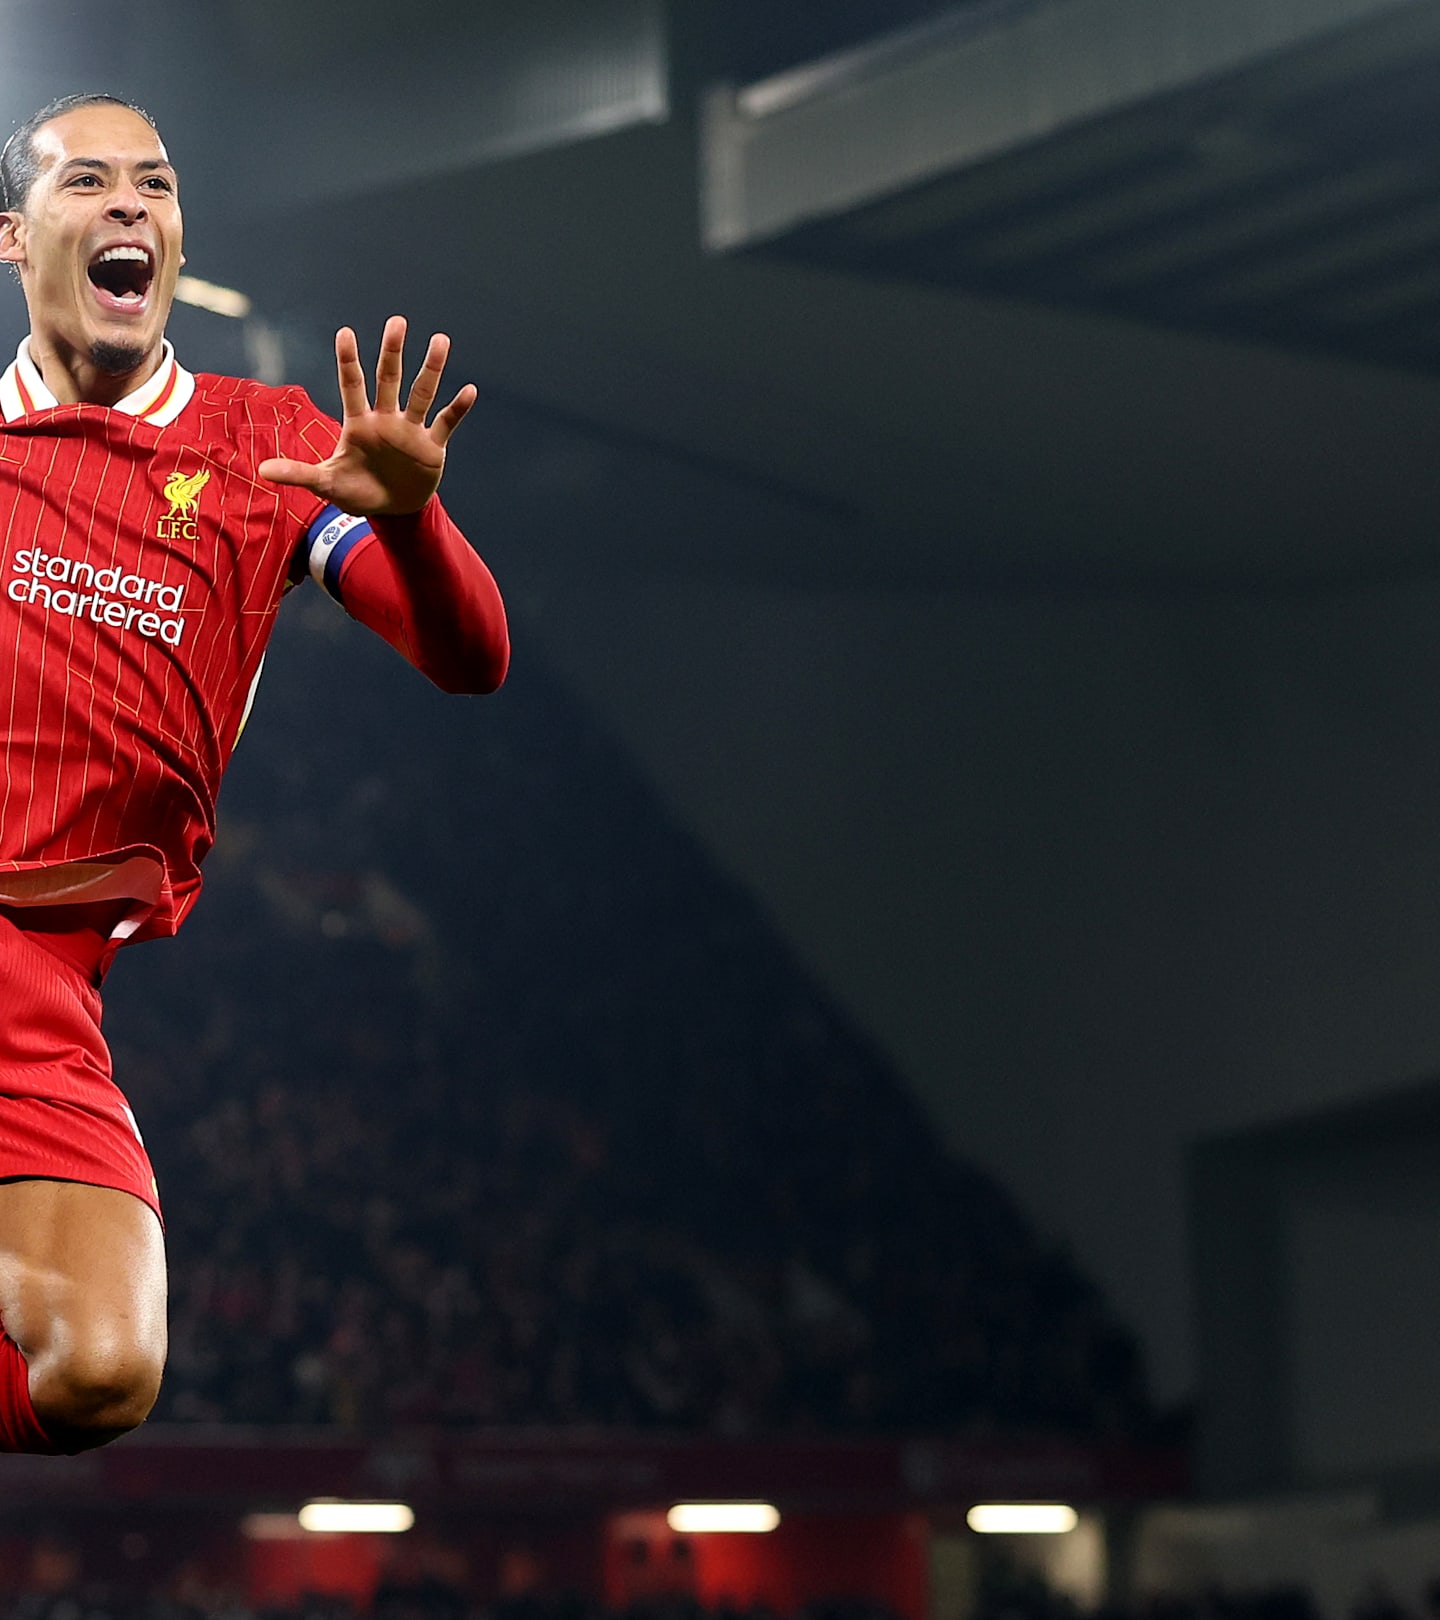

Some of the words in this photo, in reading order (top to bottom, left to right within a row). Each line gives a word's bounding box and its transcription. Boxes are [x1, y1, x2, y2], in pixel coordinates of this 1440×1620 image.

[156, 520, 200, 540] L.F.C.
[7, 577, 186, 647] chartered
[12, 547, 185, 613] standard
